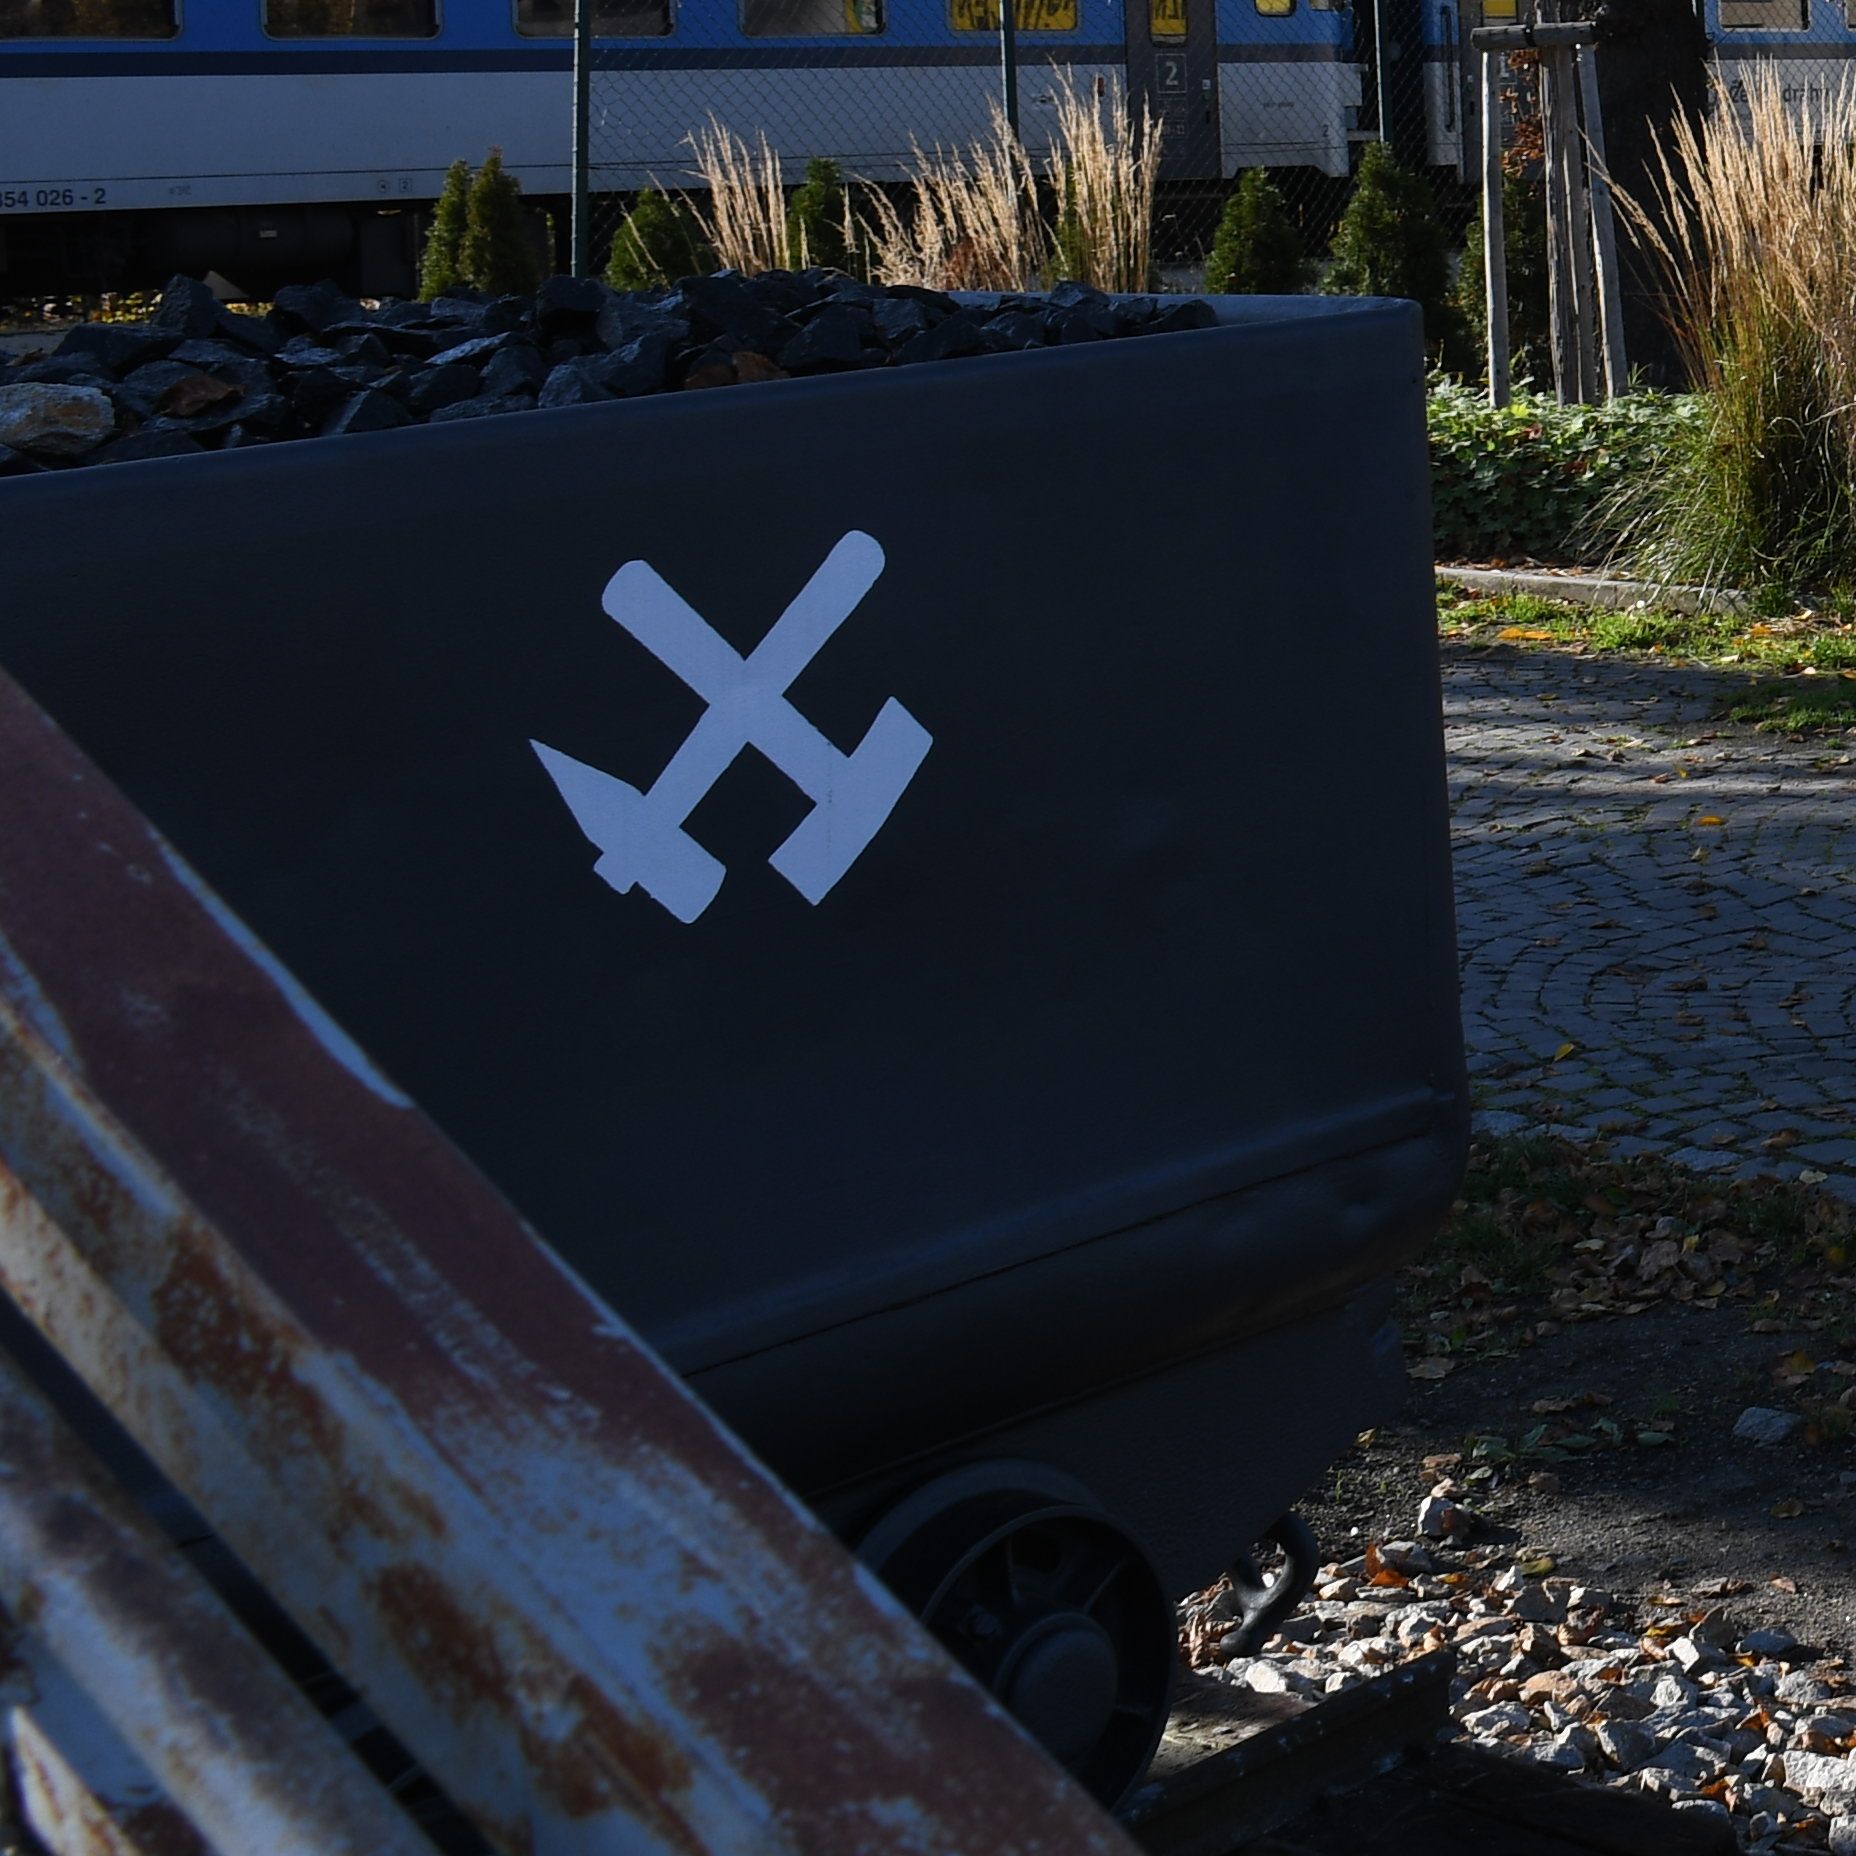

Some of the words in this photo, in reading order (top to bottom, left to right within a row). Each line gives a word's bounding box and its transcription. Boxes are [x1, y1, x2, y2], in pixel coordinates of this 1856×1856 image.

[1165, 60, 1179, 86] 2
[0, 191, 29, 208] 54
[36, 188, 74, 206] 026
[94, 188, 106, 205] 2
